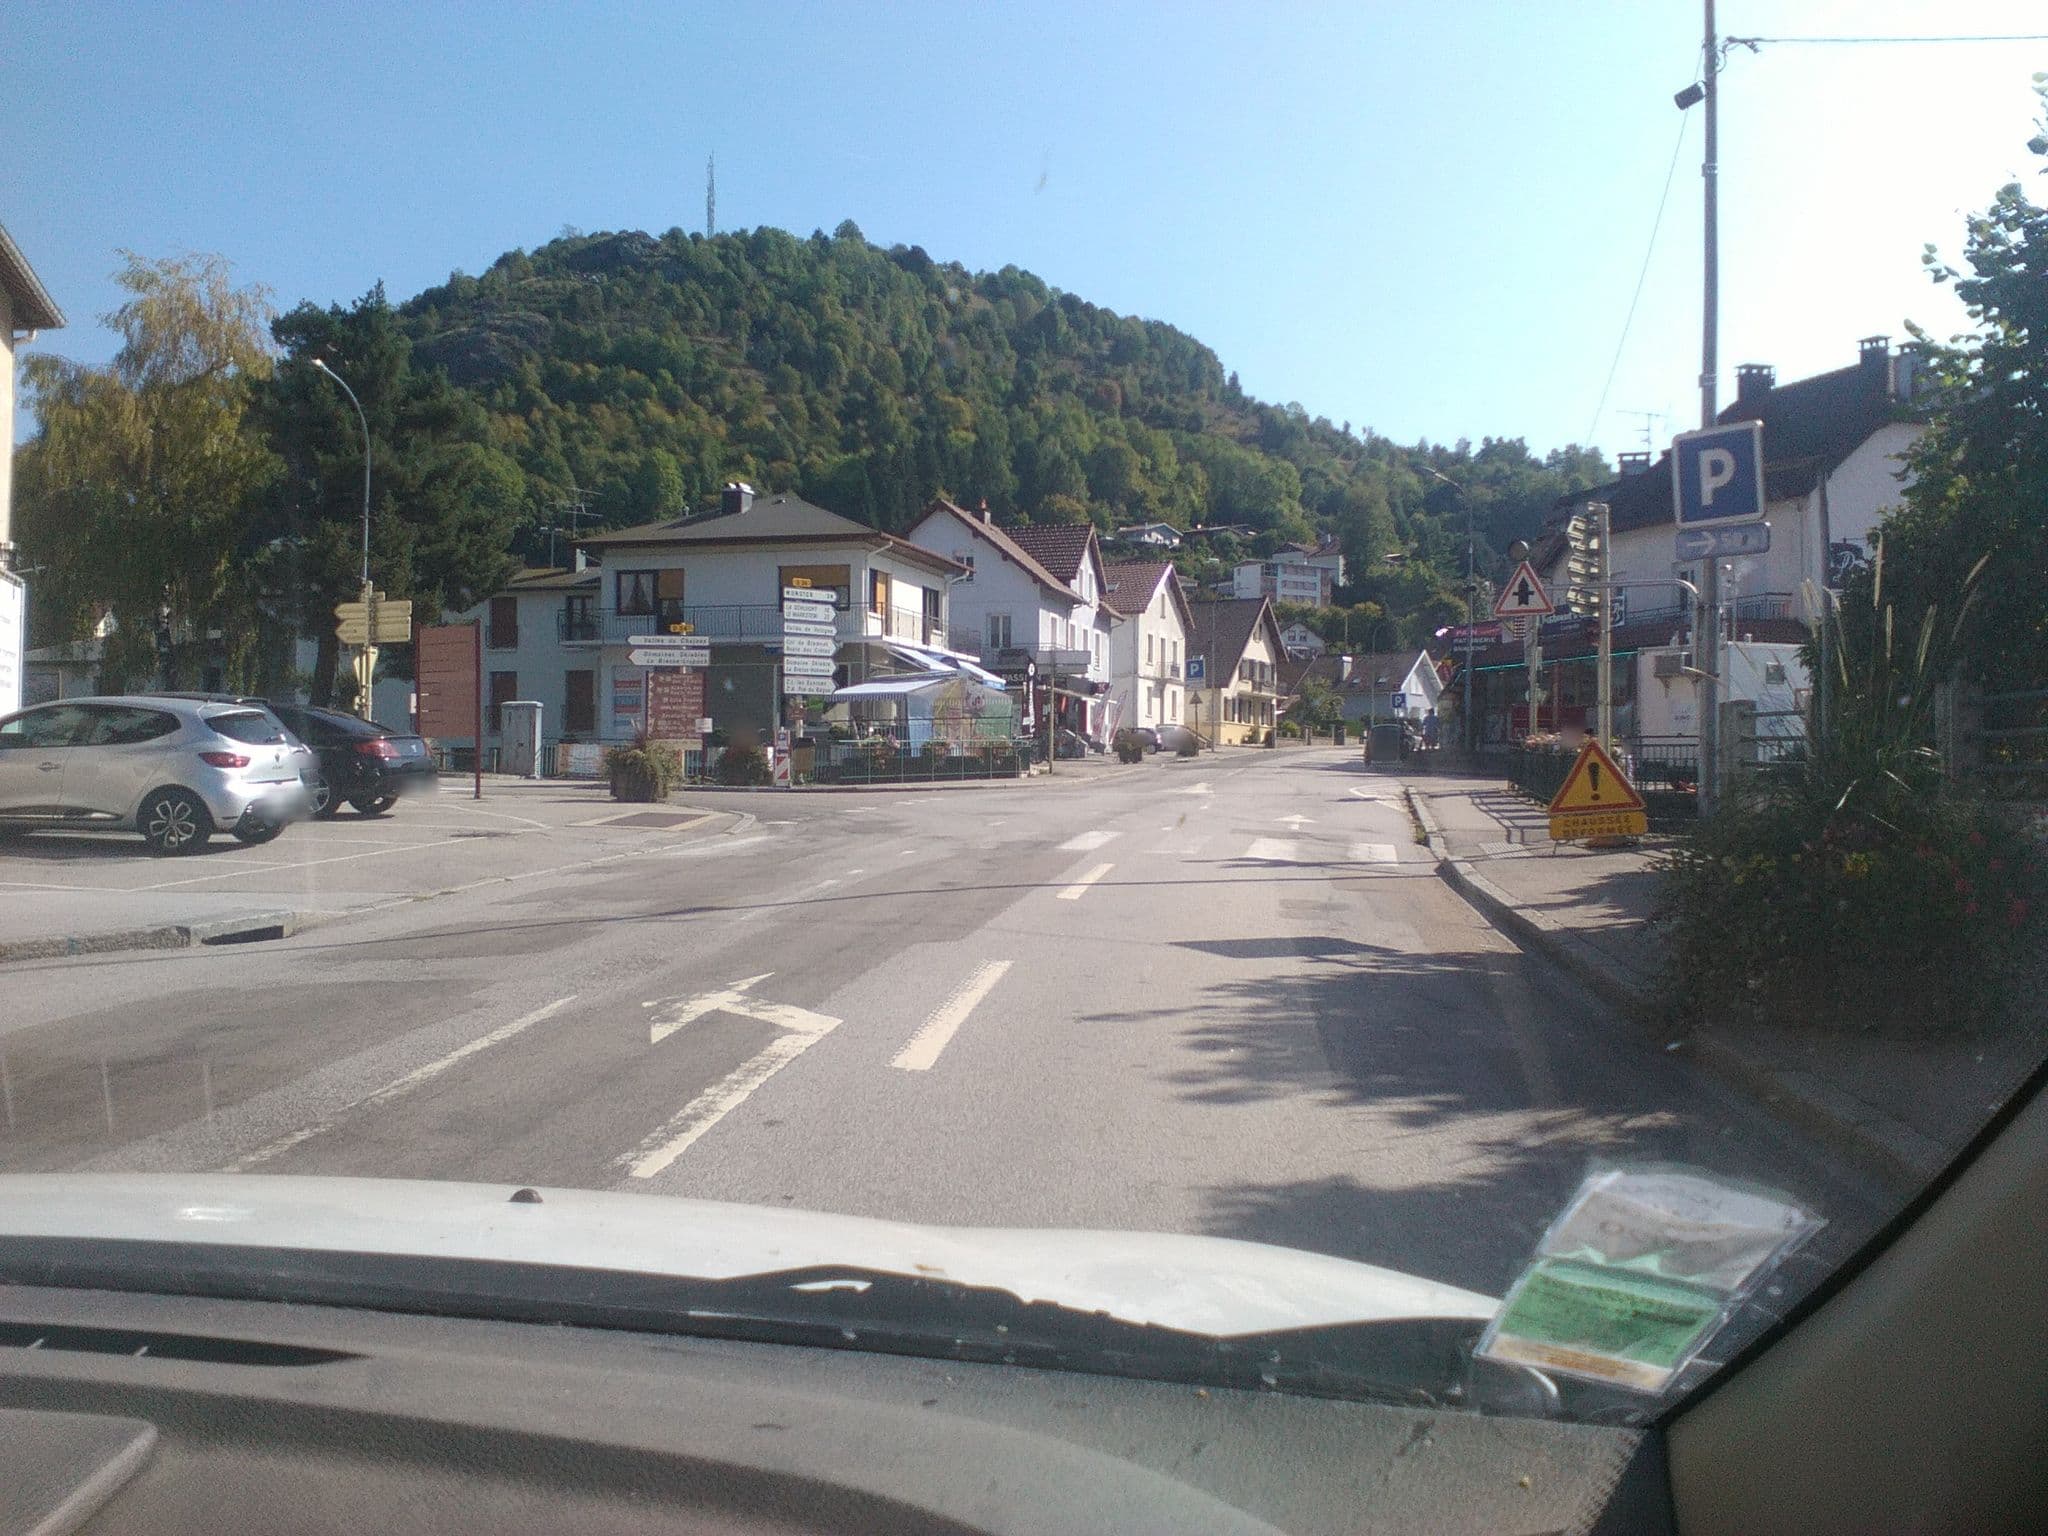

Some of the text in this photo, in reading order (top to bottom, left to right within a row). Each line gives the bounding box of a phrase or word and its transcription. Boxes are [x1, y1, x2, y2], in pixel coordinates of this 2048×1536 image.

[1700, 448, 1737, 506] P
[1190, 663, 1200, 676] P
[1002, 673, 1041, 681] PASSIN
